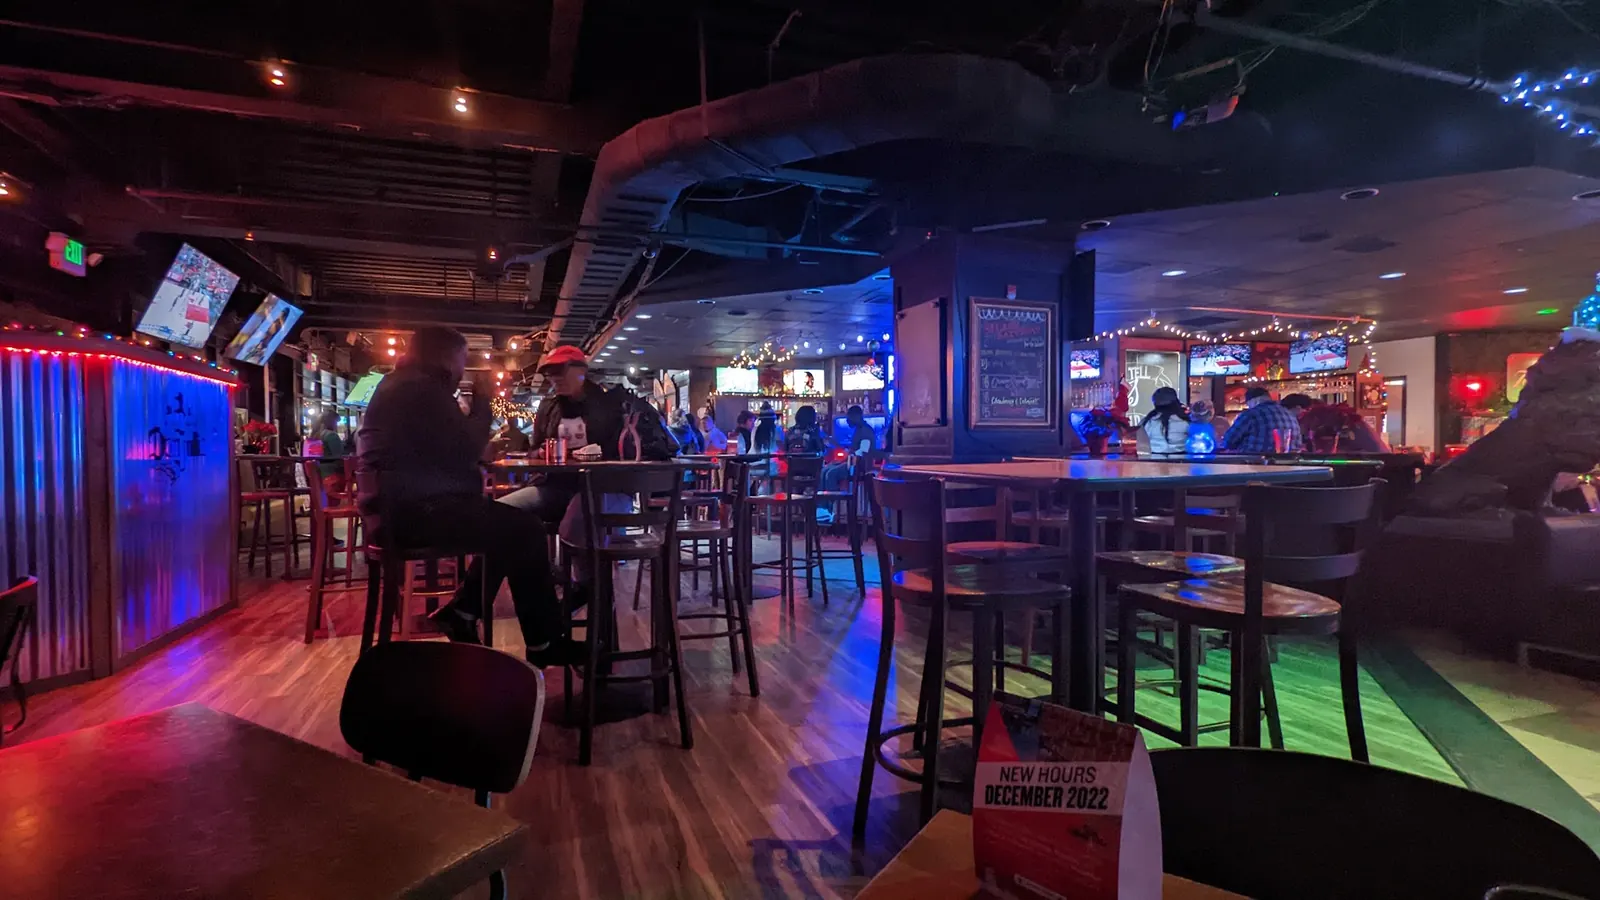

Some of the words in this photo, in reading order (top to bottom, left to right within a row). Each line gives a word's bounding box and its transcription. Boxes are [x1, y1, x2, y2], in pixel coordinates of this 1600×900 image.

[65, 239, 83, 265] EXIT
[999, 765, 1035, 782] NEW
[1038, 766, 1097, 783] HOURS
[984, 784, 1064, 807] DECEMBER
[1066, 786, 1110, 810] 2022
